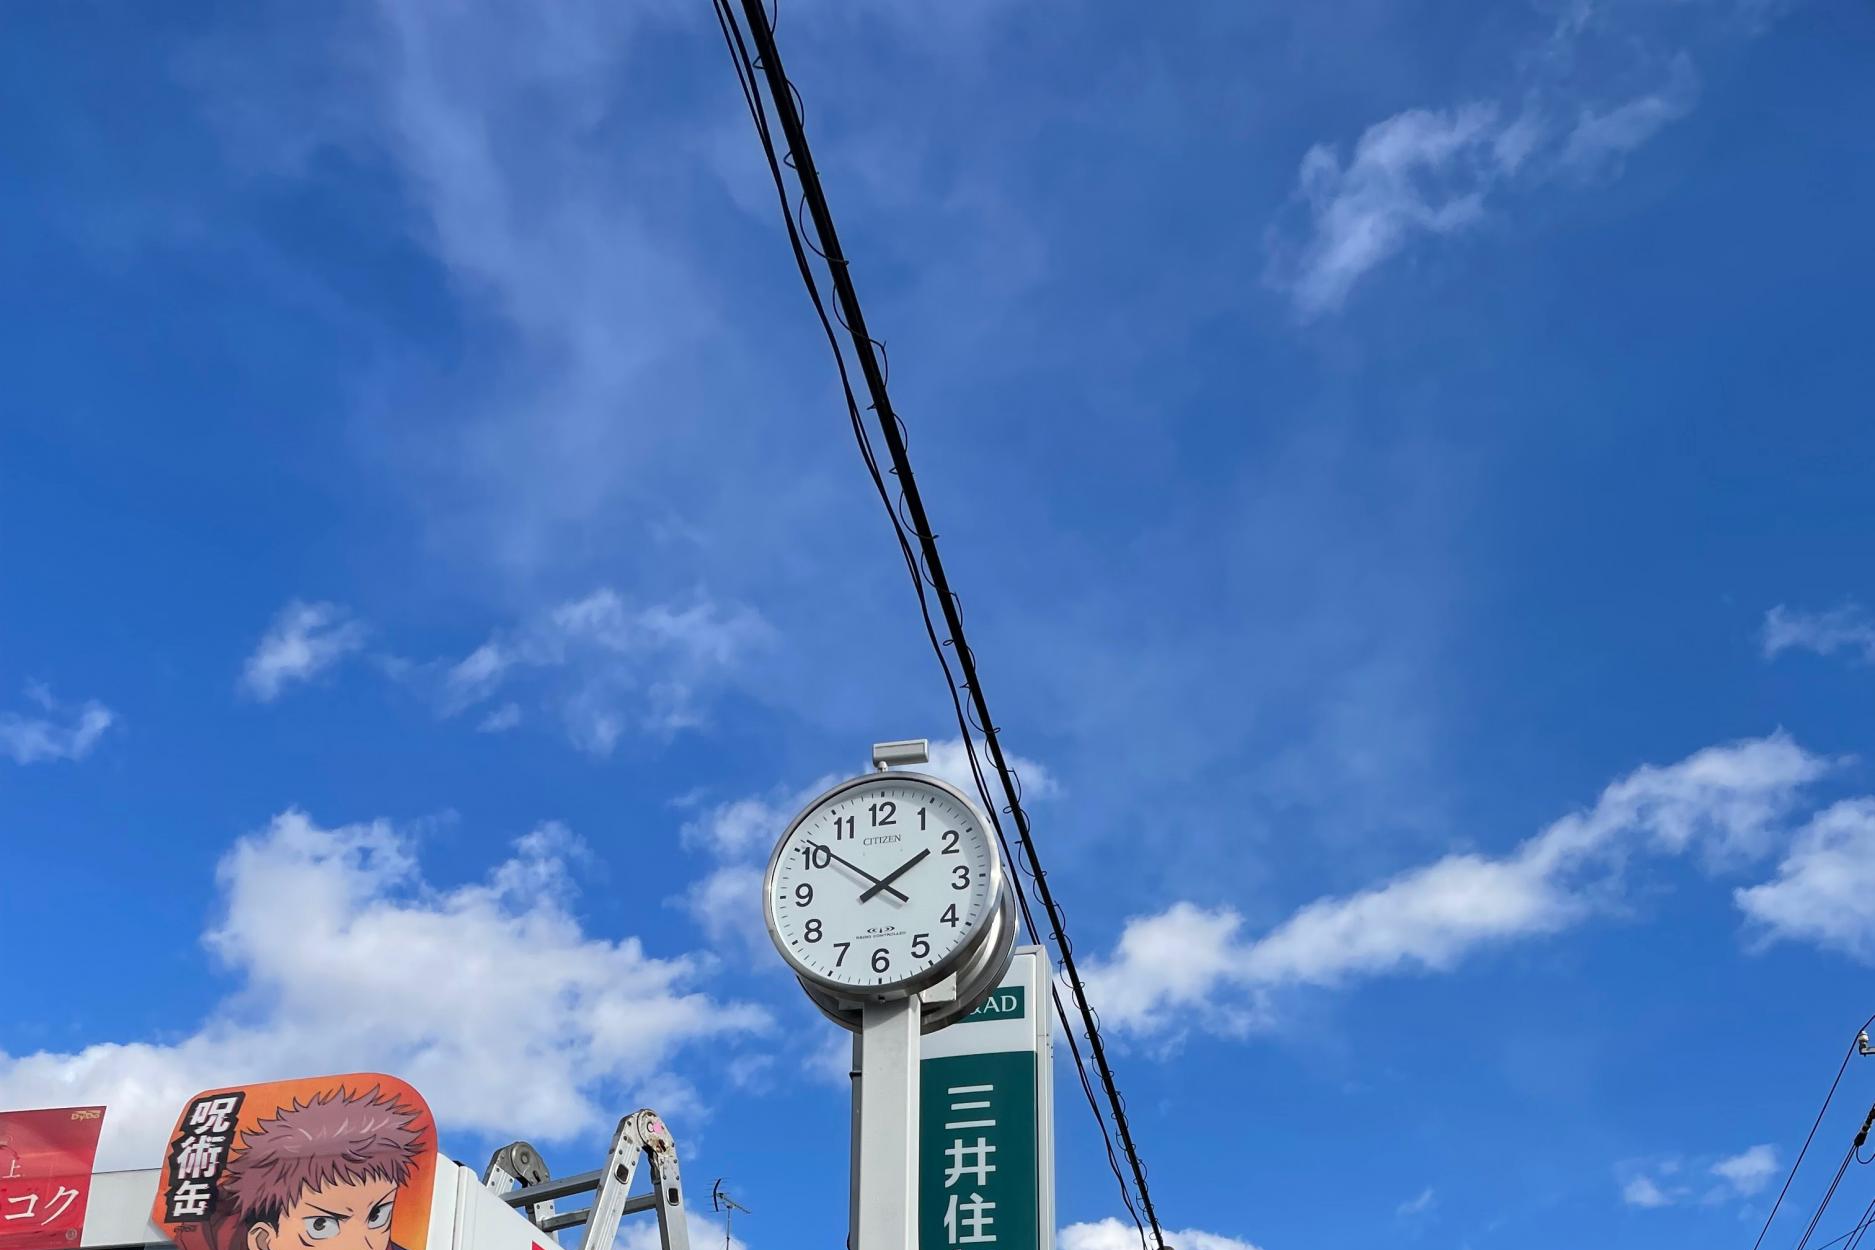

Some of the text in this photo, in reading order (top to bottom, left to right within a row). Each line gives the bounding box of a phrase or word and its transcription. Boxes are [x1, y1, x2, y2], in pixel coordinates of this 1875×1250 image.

[869, 801, 896, 827] 12
[917, 807, 926, 831] 1
[834, 815, 855, 840] 11
[863, 834, 902, 846] CITIZEN
[941, 830, 960, 855] 2
[801, 844, 831, 870] 10
[951, 865, 970, 890] 3
[795, 883, 814, 907] 9
[940, 903, 959, 928] 4
[804, 918, 823, 943] 8
[833, 942, 851, 967] 7
[911, 933, 930, 959] 5
[871, 948, 890, 973] 6
[172, 1096, 239, 1217] 呪術缶
